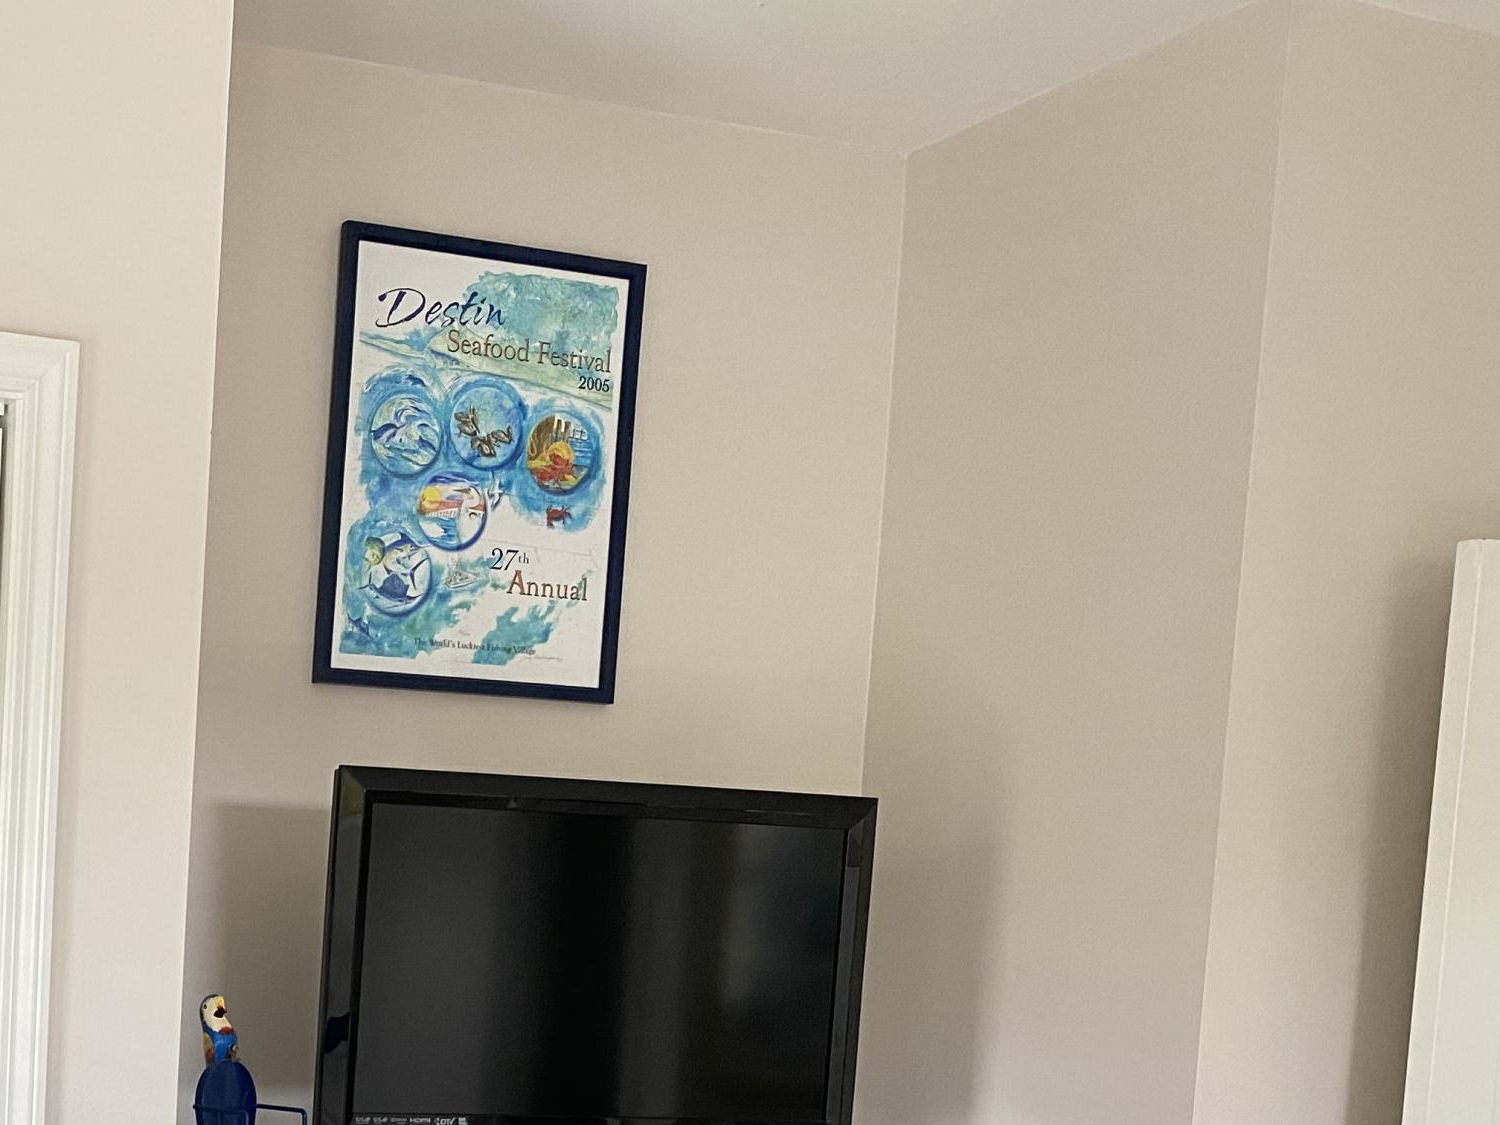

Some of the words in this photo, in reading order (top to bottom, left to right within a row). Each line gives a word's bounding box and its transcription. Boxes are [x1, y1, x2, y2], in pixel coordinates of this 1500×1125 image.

[375, 288, 505, 328] Destin
[447, 330, 529, 362] Seafood
[537, 340, 612, 373] Festival
[578, 375, 610, 393] 2005
[490, 547, 530, 571] 27th
[506, 569, 588, 601] Annual
